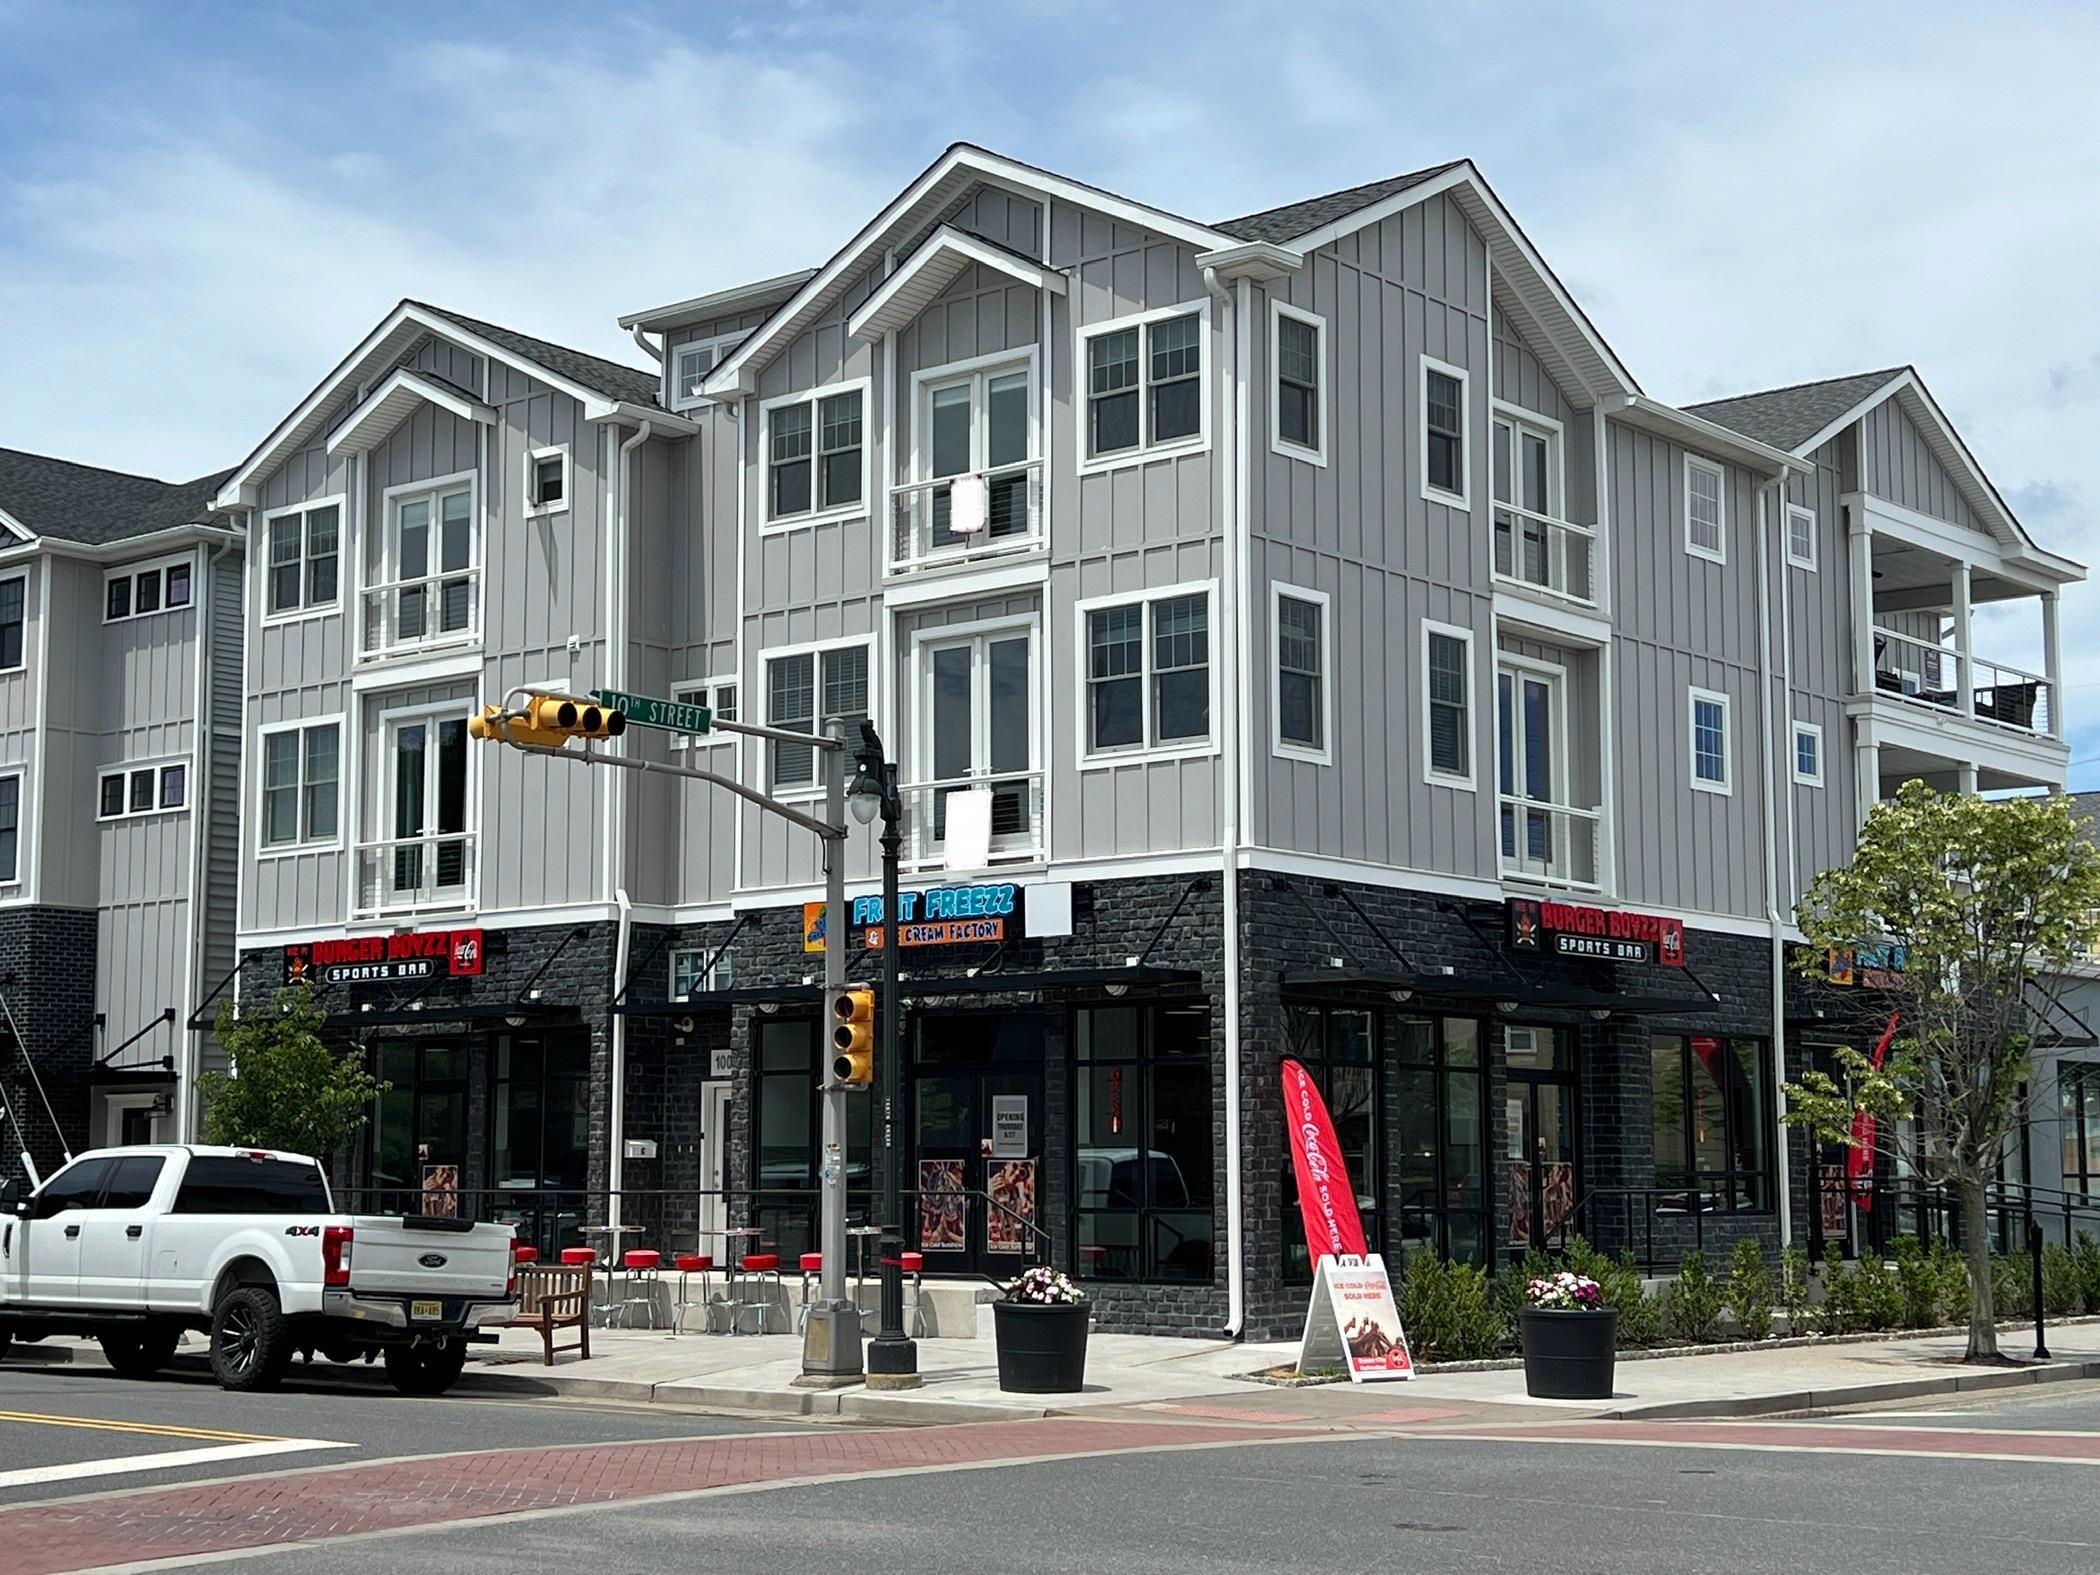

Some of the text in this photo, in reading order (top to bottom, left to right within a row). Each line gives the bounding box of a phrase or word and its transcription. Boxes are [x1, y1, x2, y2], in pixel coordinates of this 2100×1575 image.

[648, 702, 702, 730] STREET
[853, 884, 1015, 925] FRIT FREEZZ
[905, 925, 945, 943] CREAM
[948, 921, 999, 941] FACTORY
[1541, 902, 1606, 936] BURGER
[1609, 911, 1660, 942] BOYZZ
[312, 932, 448, 965] BURGER BOYZZ
[1559, 937, 1643, 959] SPORTS BAR
[332, 962, 427, 981] SPORTS BAR
[1297, 1068, 1307, 1089] ICE
[996, 1112, 1025, 1121] OPENING
[1301, 1089, 1313, 1122] COLD
[1319, 1184, 1334, 1218] SOLD
[1327, 1218, 1343, 1254] HERE
[1333, 1281, 1345, 1290] ICE
[1346, 1281, 1363, 1290] COLD
[1344, 1292, 1382, 1300] SOLD HERE
